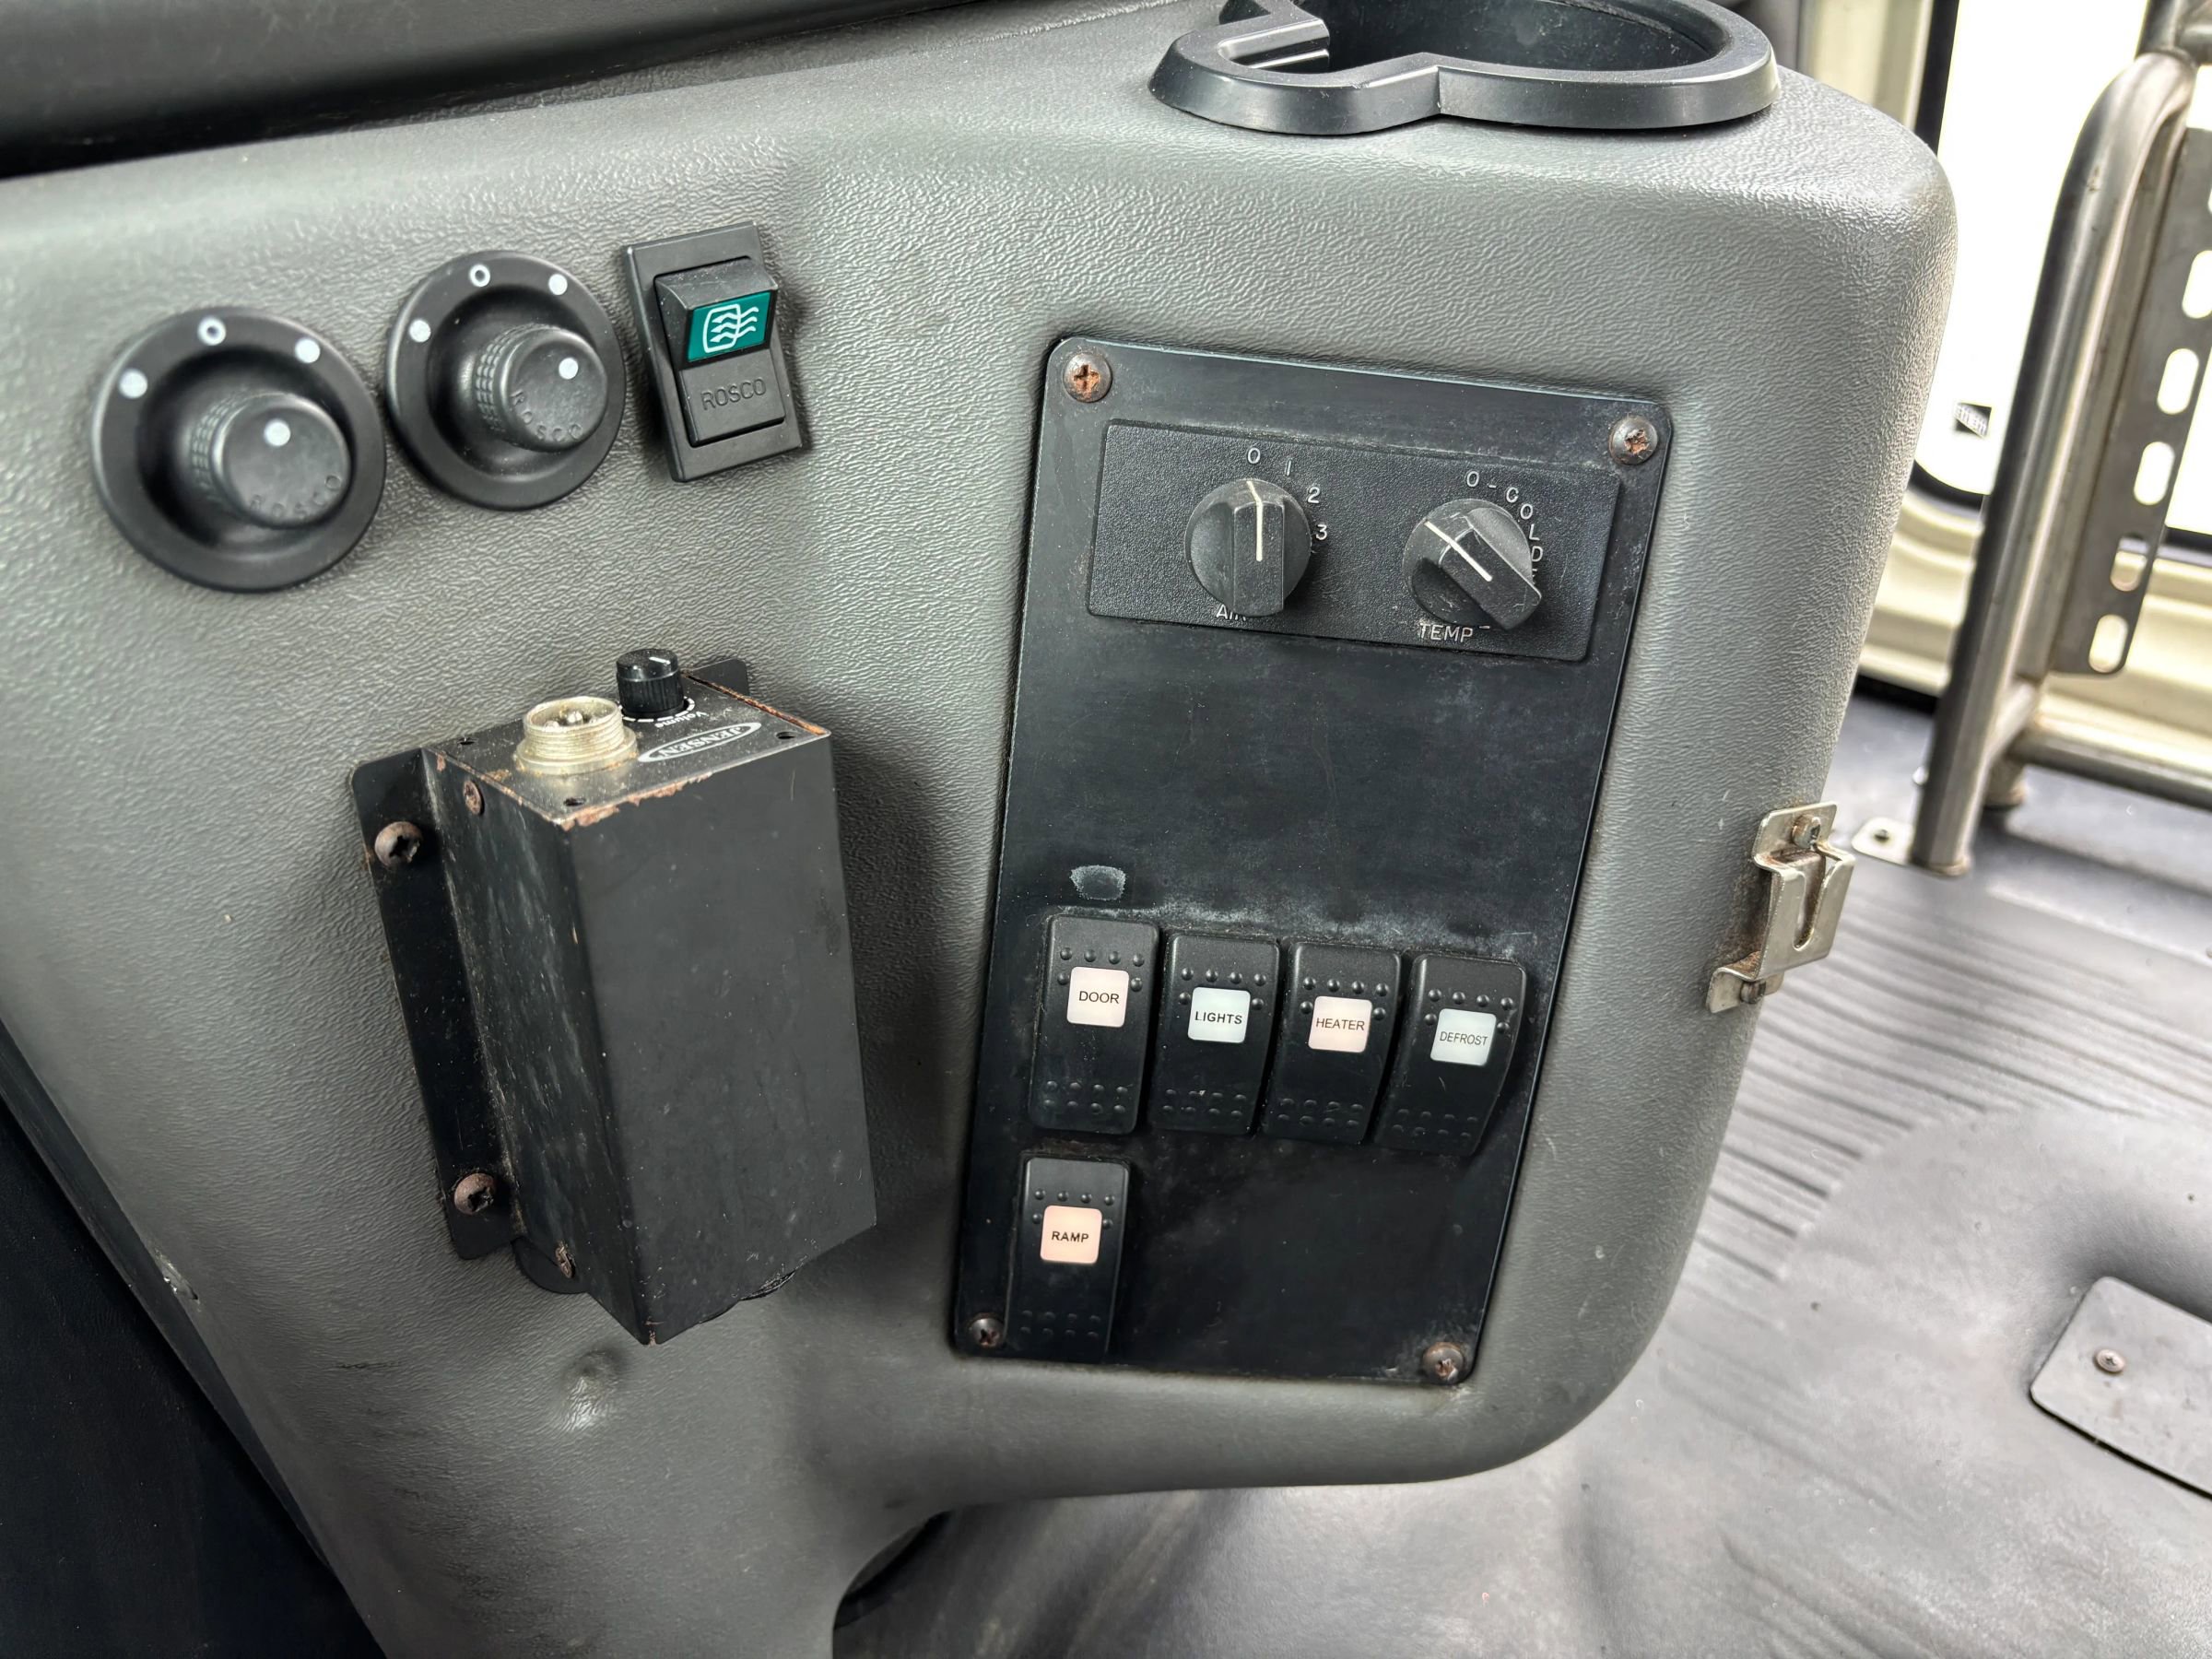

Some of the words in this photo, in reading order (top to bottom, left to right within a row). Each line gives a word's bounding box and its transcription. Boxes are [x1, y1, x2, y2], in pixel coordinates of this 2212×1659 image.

[700, 377, 767, 411] ROSCO
[510, 389, 583, 441] ROSCO
[1307, 488, 1321, 504] 2
[1315, 524, 1328, 541] 3
[1419, 622, 1474, 643] TEMP
[654, 711, 709, 728] Volume
[658, 726, 742, 757] JENSEN
[1078, 990, 1120, 1005] DOOR
[1194, 1011, 1243, 1026] LIGHTS
[1315, 1017, 1366, 1032] HEATER
[1439, 1031, 1488, 1047] DEFROST
[1051, 1230, 1089, 1244] RAMP
